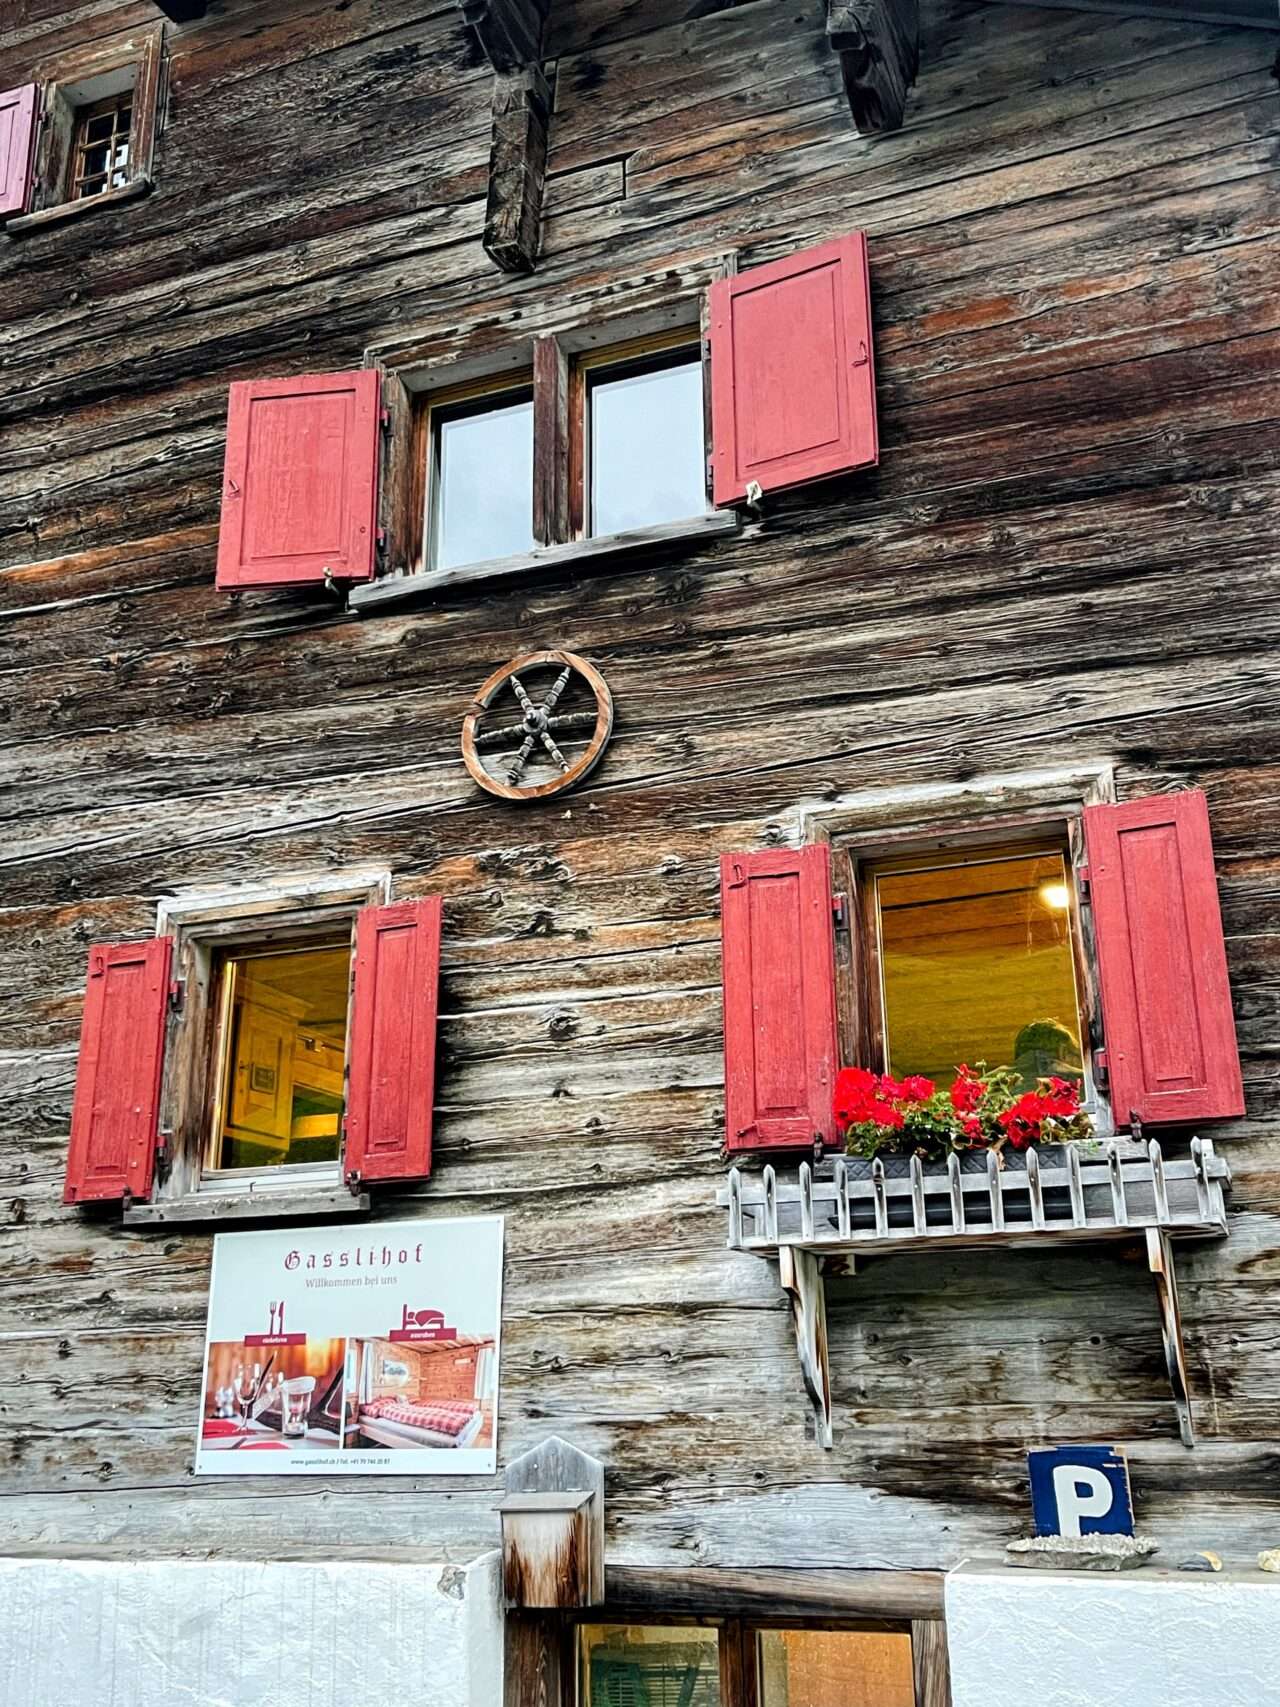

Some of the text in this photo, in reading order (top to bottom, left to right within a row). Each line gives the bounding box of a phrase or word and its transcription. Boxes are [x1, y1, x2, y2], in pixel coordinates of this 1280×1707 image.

[284, 1243, 422, 1270] Gasslihof
[305, 1275, 398, 1288] Willkommen bei uns
[1053, 1465, 1113, 1537] P
